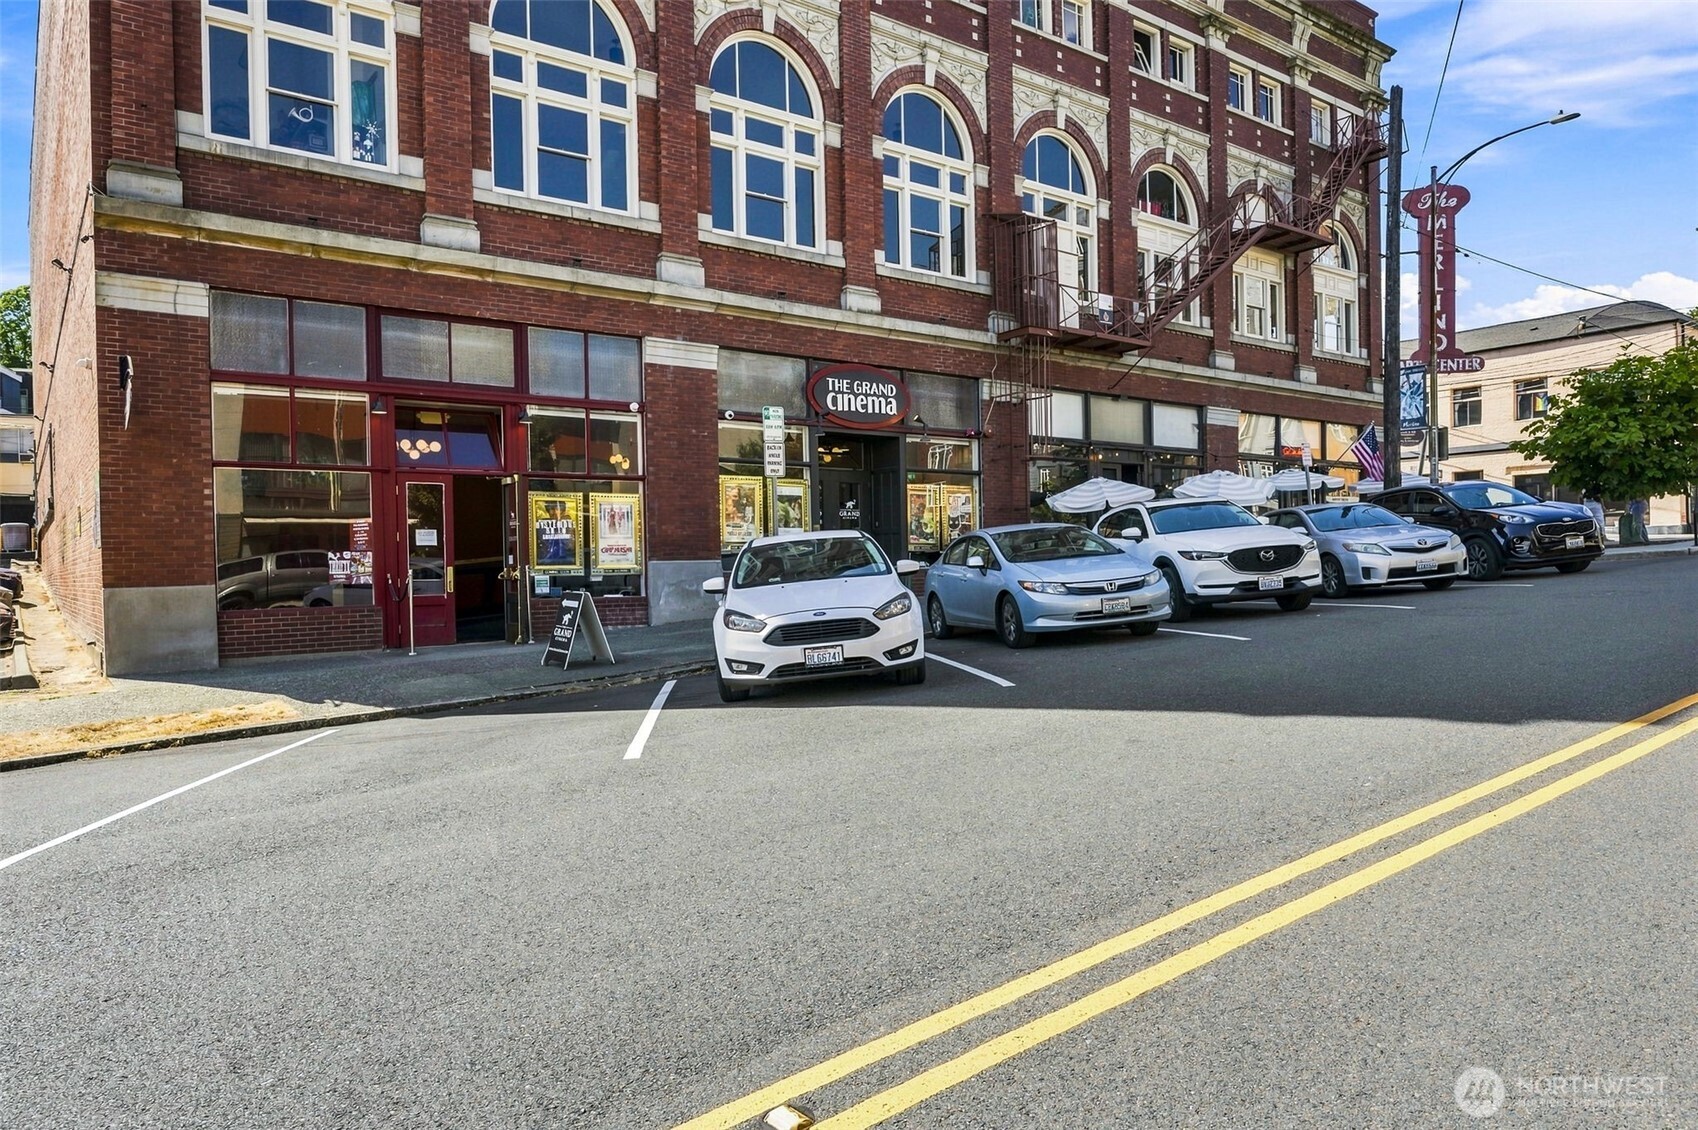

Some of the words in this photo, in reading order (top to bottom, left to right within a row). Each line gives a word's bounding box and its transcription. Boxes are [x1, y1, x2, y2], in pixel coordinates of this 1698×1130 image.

[1417, 191, 1458, 209] The
[826, 377, 851, 393] THE
[853, 380, 897, 397] GRAND
[553, 627, 573, 638] GRAND
